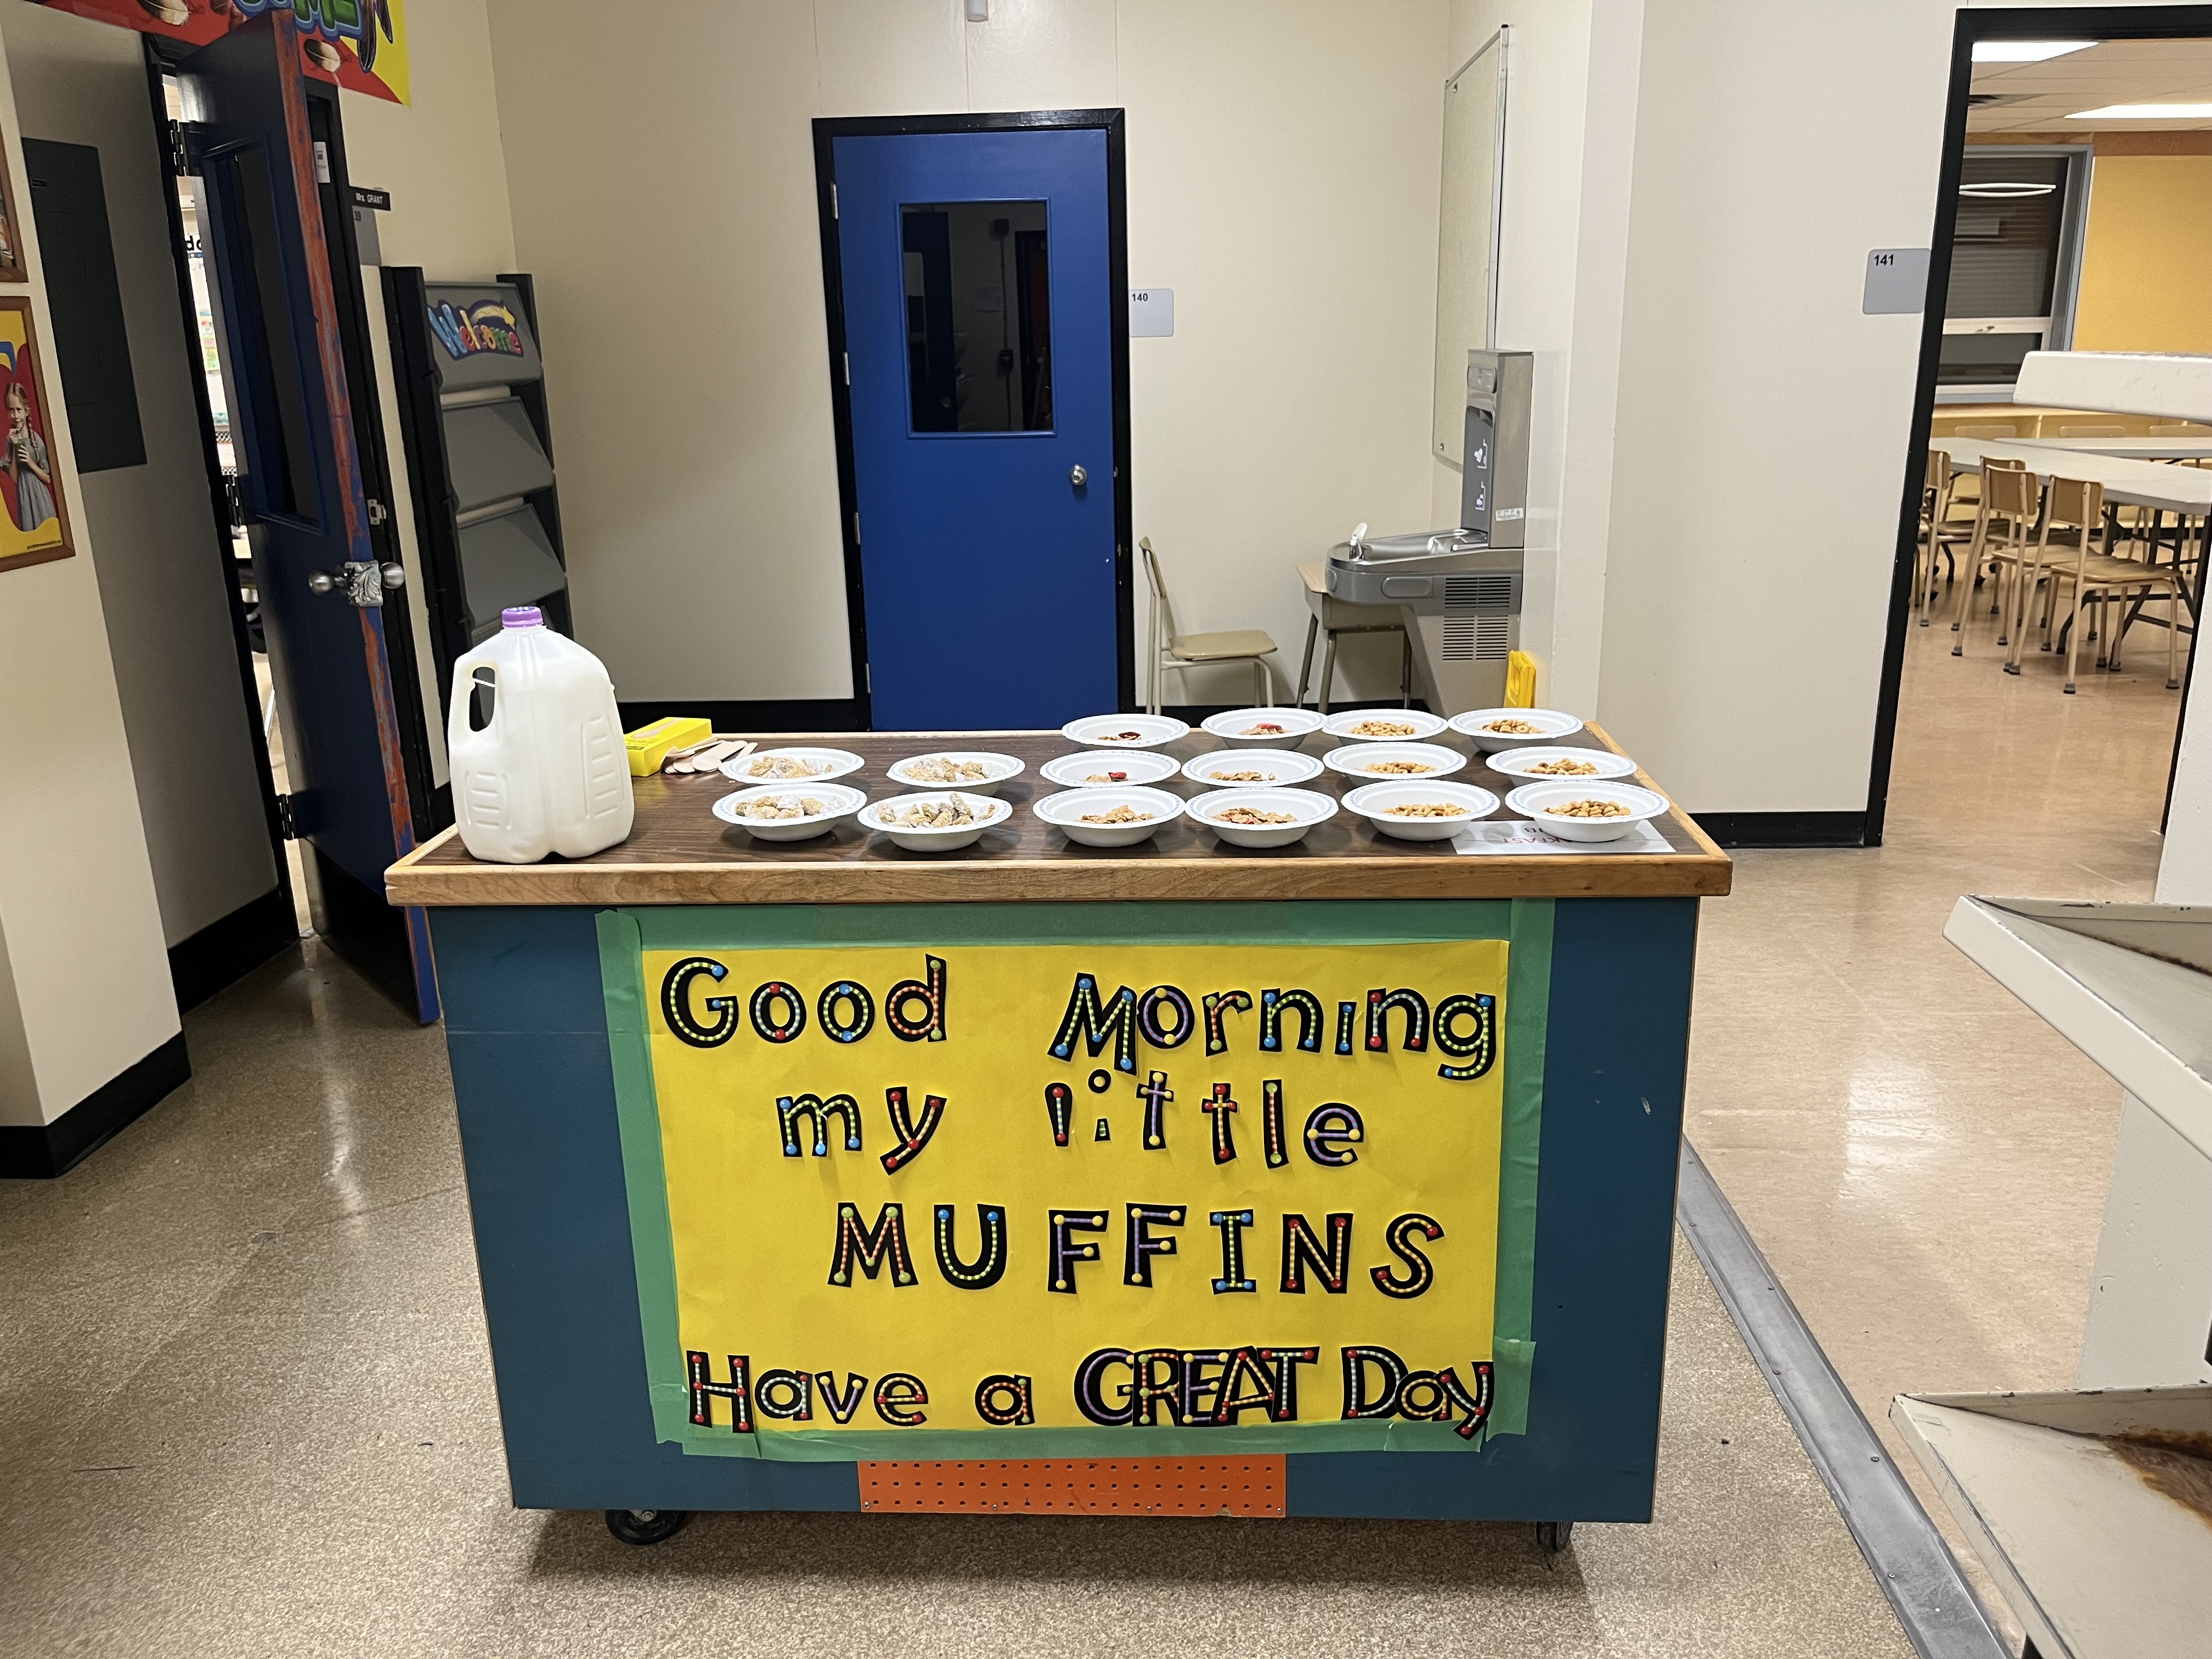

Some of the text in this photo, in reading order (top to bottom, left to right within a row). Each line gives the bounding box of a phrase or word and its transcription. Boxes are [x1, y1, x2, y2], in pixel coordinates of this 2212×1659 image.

[1132, 293, 1148, 302] 140
[1874, 255, 1893, 266] 141
[427, 304, 522, 357] Welcome
[661, 953, 1497, 1081] Good Morning
[776, 1069, 1365, 1176] my little
[827, 1203, 1445, 1300] MUFFINS
[686, 1345, 1494, 1441] Have a GREAT Day
